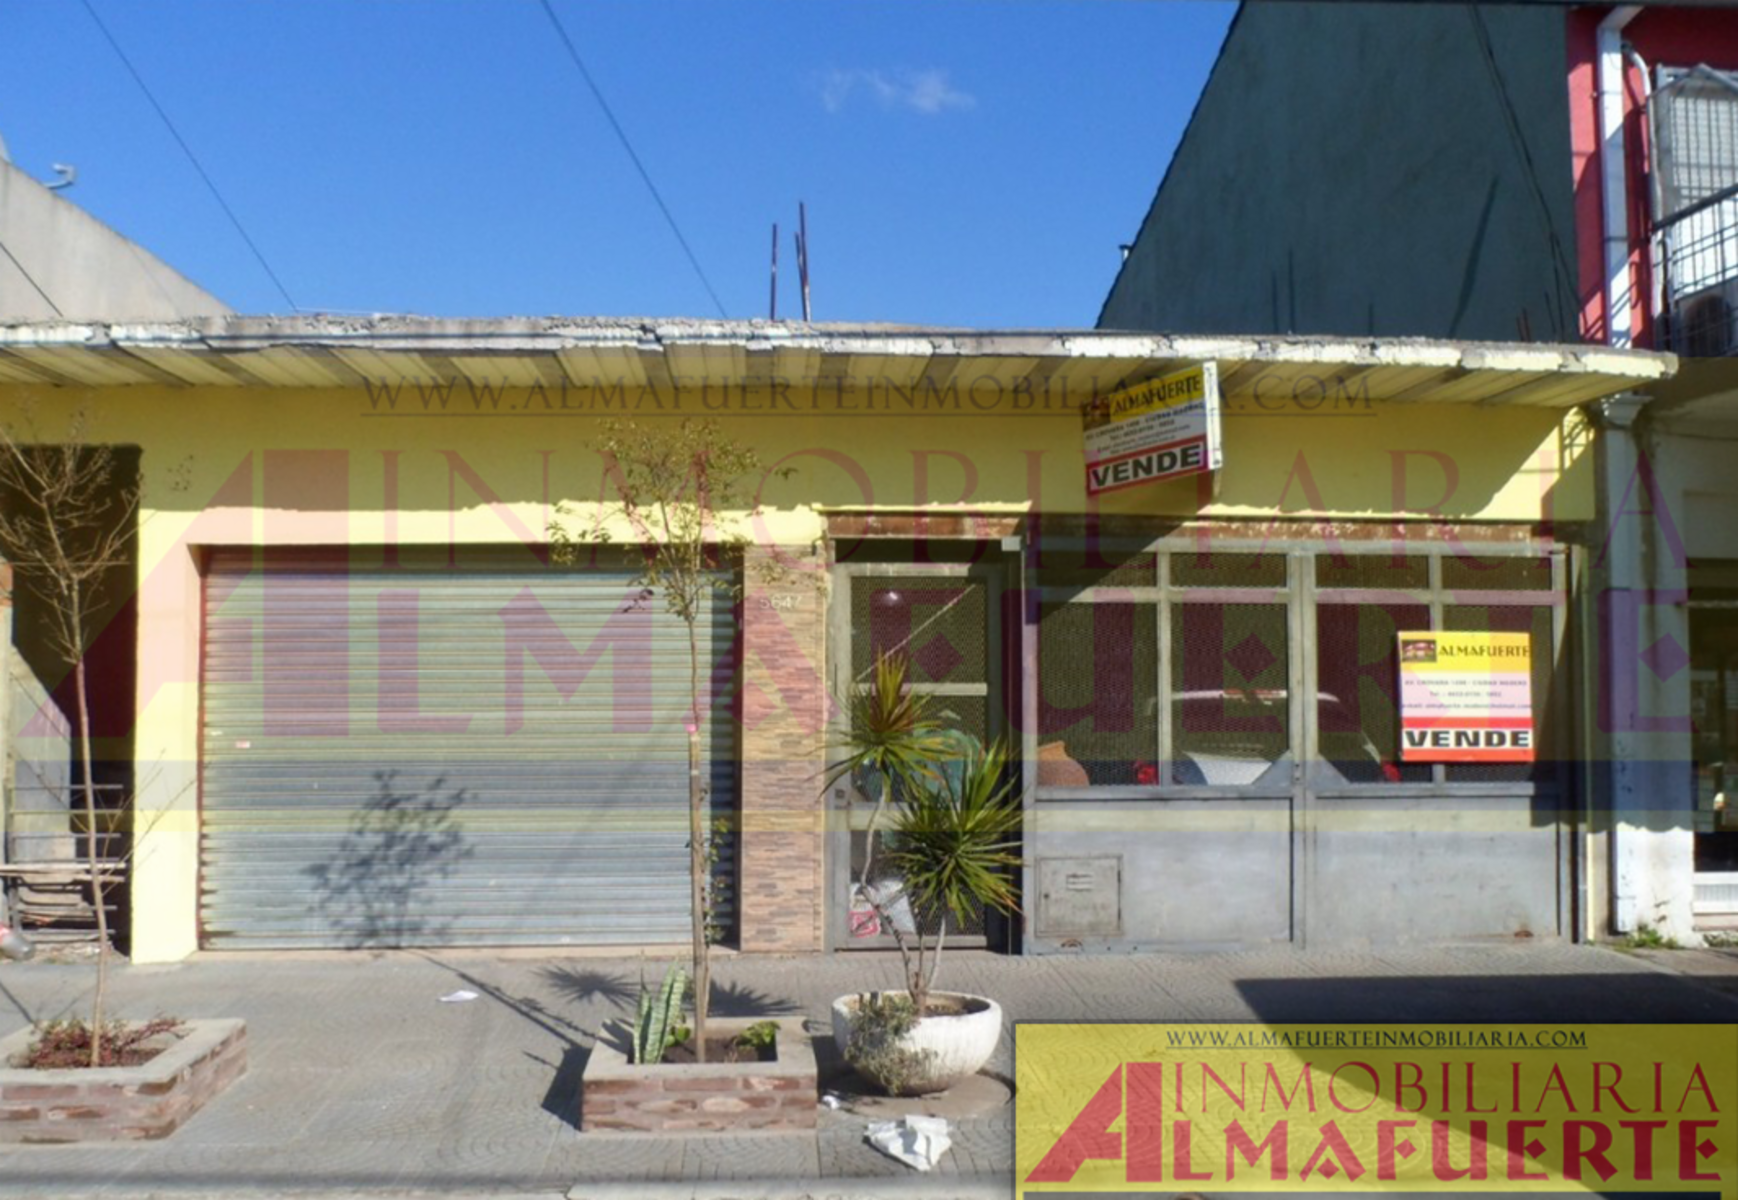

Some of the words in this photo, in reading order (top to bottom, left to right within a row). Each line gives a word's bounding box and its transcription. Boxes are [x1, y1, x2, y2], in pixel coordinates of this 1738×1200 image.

[1113, 374, 1200, 416] ALMAFUERTE
[1092, 445, 1201, 487] VENDE
[1438, 645, 1531, 658] ALMAFUERTE
[1405, 730, 1529, 748] VENDE
